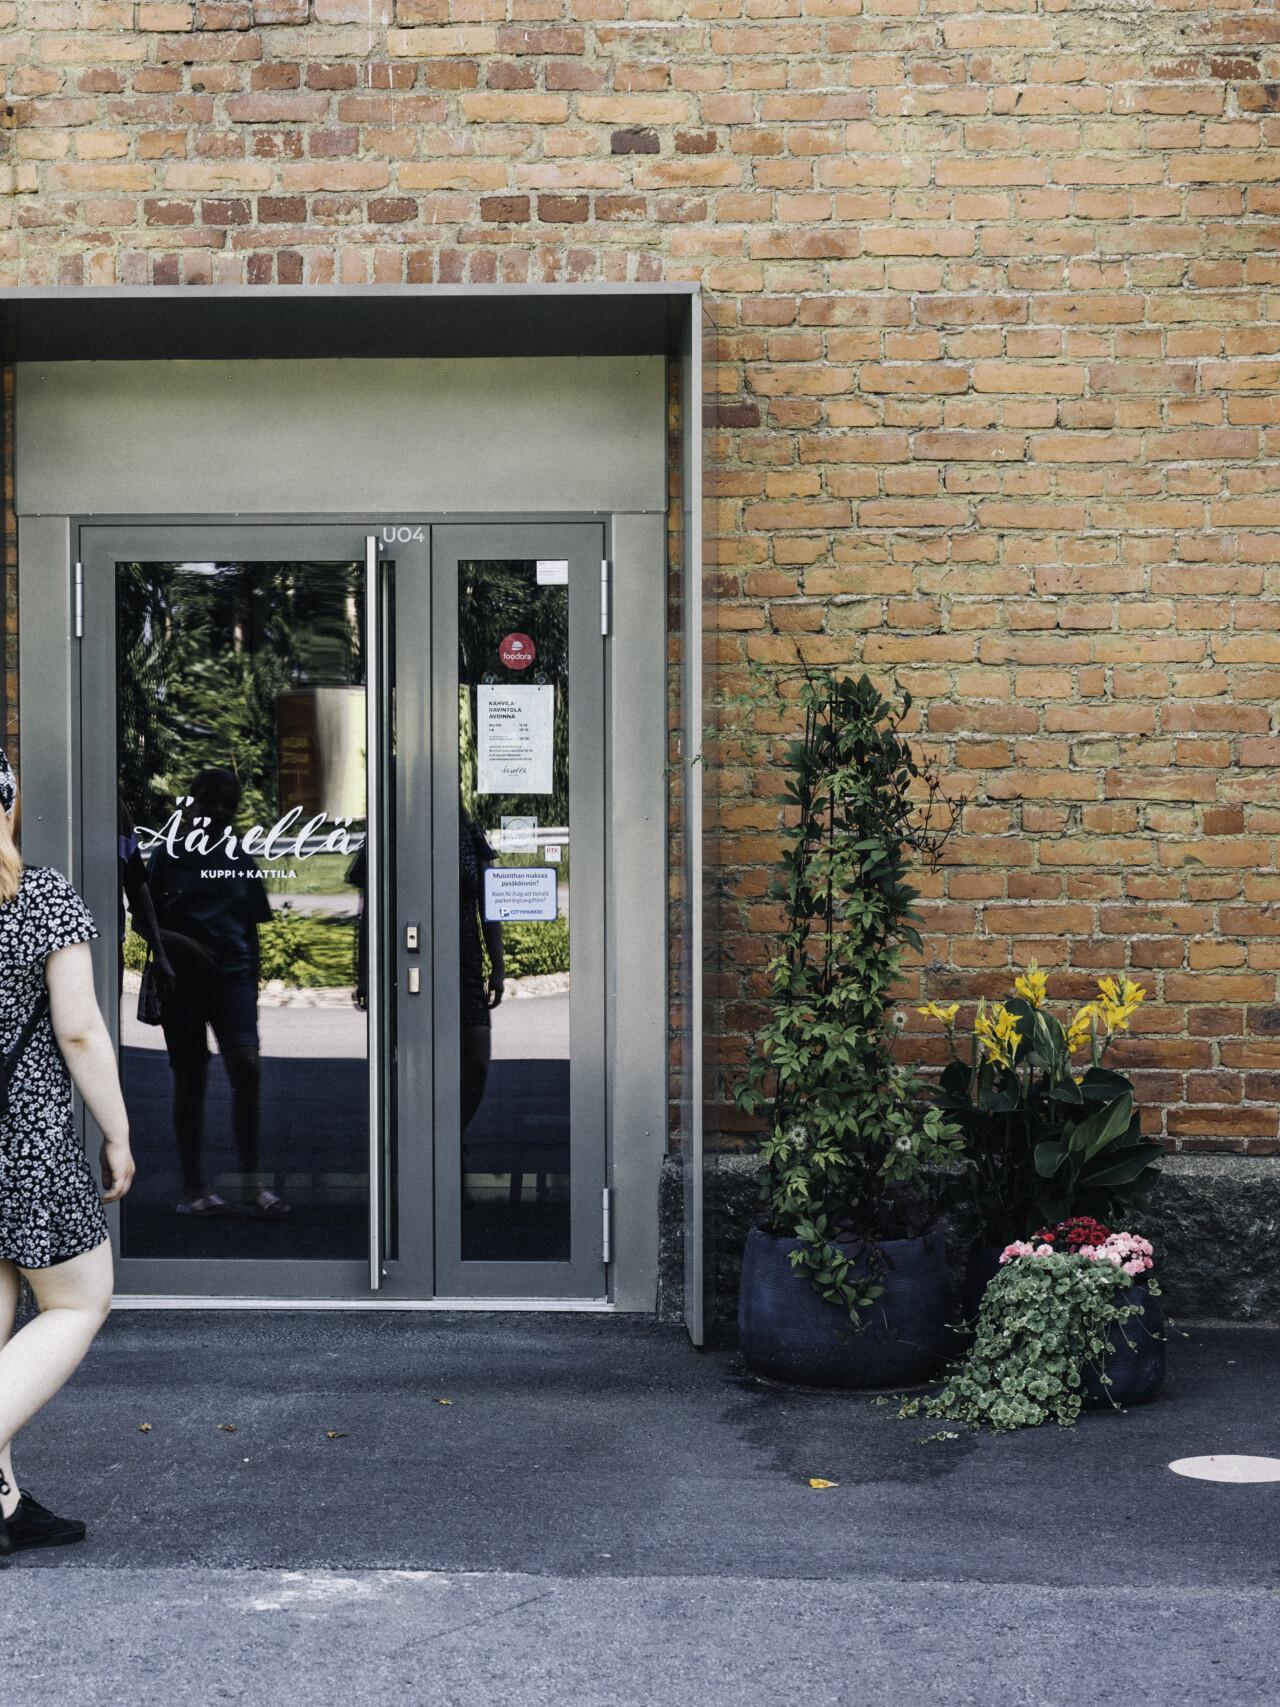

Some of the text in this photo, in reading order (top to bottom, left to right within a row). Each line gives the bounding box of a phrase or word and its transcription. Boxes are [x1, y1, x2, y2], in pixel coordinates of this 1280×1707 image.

[503, 652, 532, 660] foodora
[133, 796, 365, 861] Äärellä
[200, 869, 236, 879] KUPPI
[246, 869, 297, 879] KATTILA
